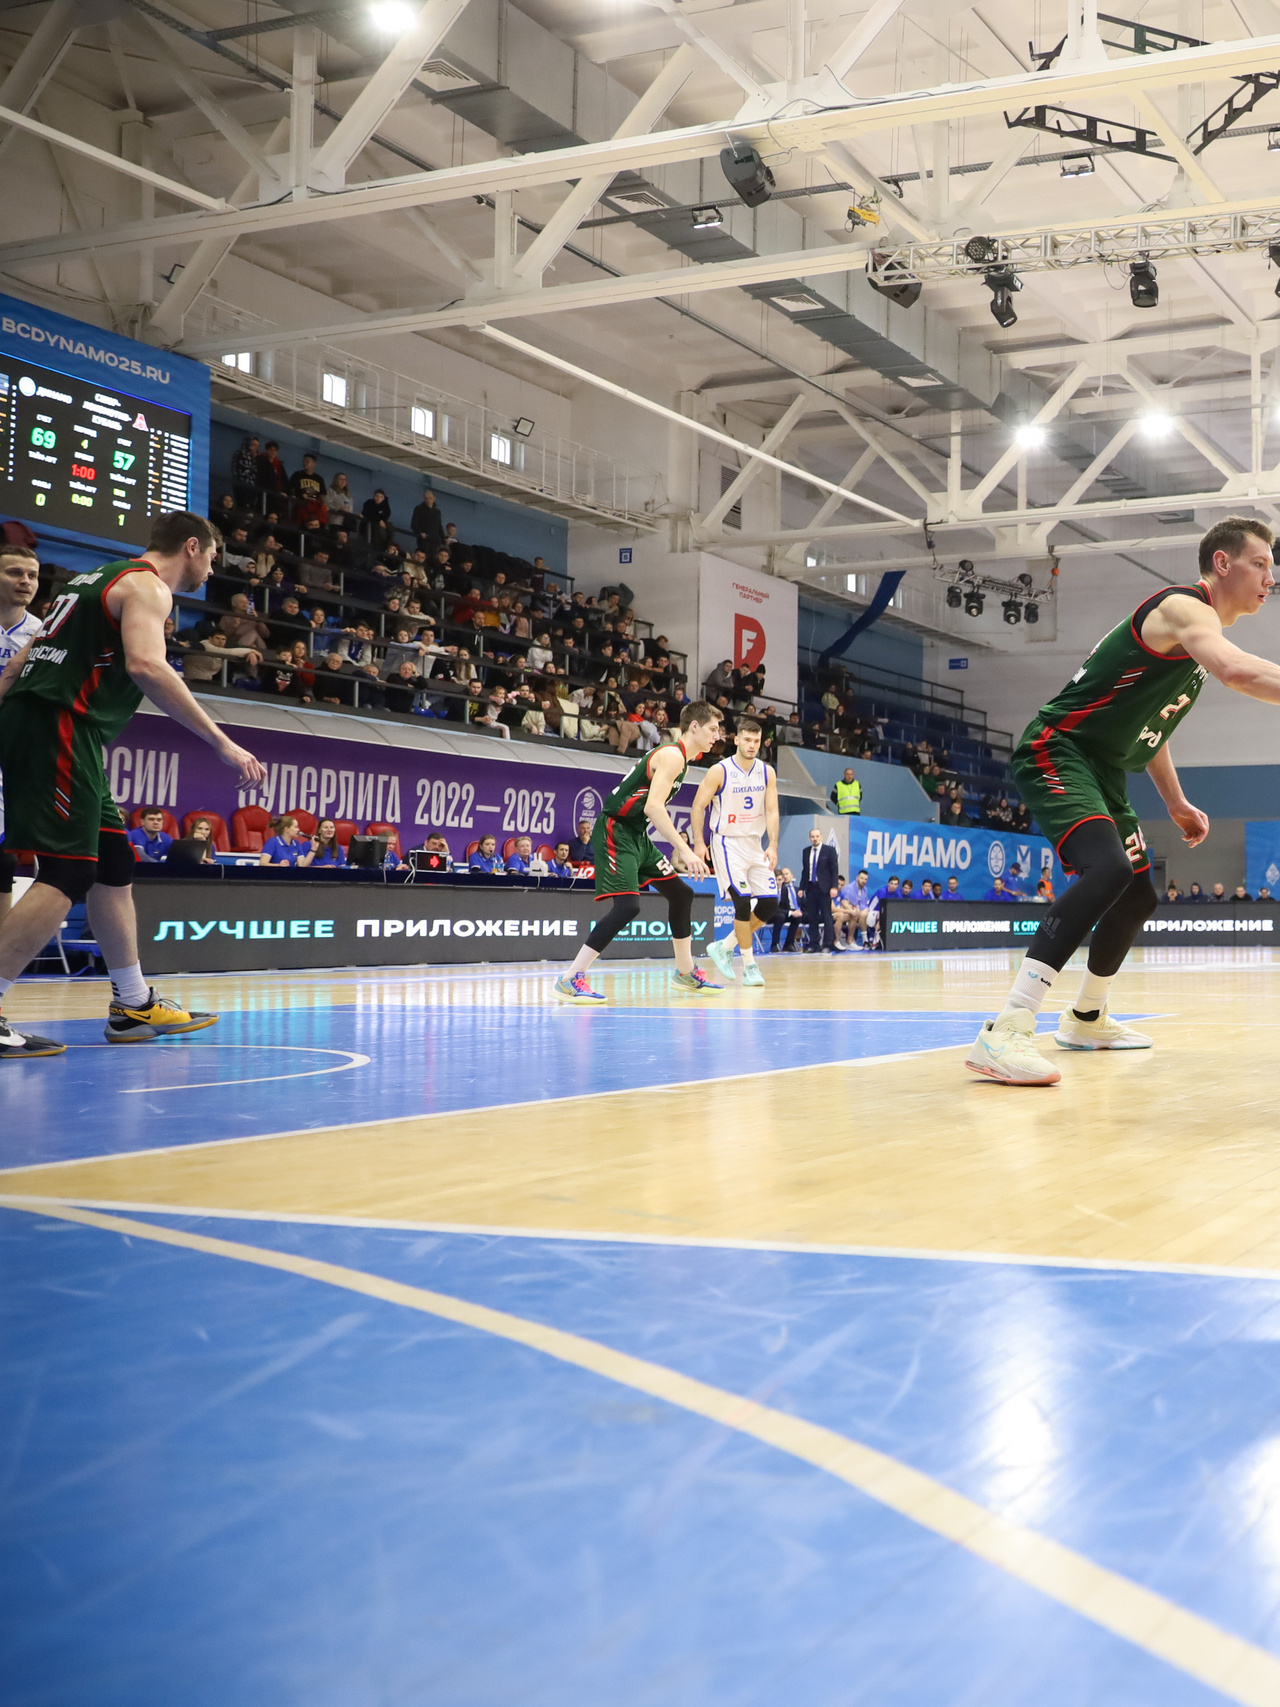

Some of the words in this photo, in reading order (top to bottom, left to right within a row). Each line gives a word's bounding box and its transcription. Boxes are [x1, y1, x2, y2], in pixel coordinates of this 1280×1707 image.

[2, 317, 170, 384] BCDYNAMO25.RU
[31, 427, 56, 449] 69
[81, 439, 89, 449] 4
[113, 450, 136, 470] 57
[71, 463, 96, 480] 1:00
[35, 493, 46, 507] 0
[71, 493, 94, 508] 0:00
[118, 513, 126, 526] 1
[743, 796, 754, 810] 3
[863, 830, 972, 870] ДИНАМО
[768, 877, 777, 890] 3
[153, 920, 335, 941] ЛУЧШЕЕ
[356, 919, 578, 938] ПРИЛОЖЕНИЕ
[890, 921, 938, 934] ЛУЧШЕЕ
[942, 921, 1010, 933] ПРИЛОЖЕНИЕ
[1013, 921, 1020, 931] К
[1143, 919, 1274, 932] ПРИЛОЖЕНИЕ
